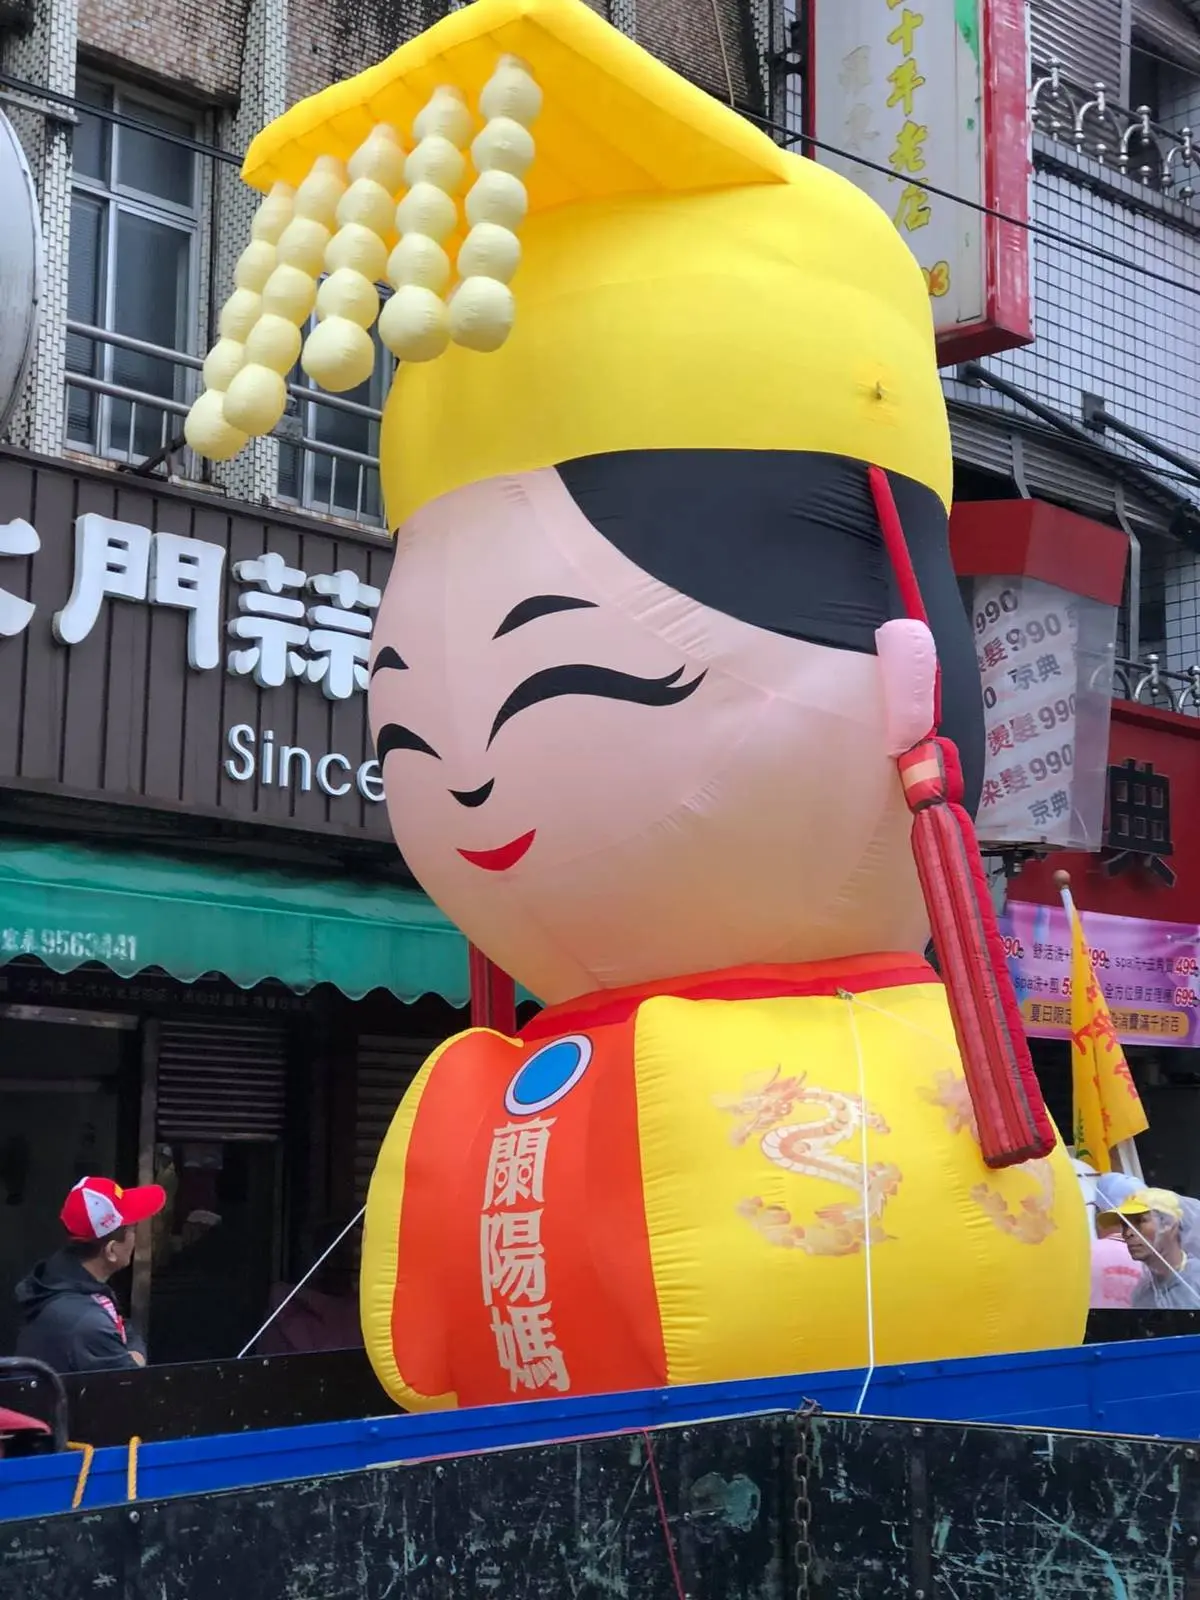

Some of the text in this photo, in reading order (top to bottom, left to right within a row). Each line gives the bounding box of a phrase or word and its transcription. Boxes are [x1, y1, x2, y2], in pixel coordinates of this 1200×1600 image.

[886, 0, 932, 233] 十年老店
[1005, 612, 1062, 652] 990
[225, 723, 386, 802] Since
[1028, 743, 1073, 782] 990
